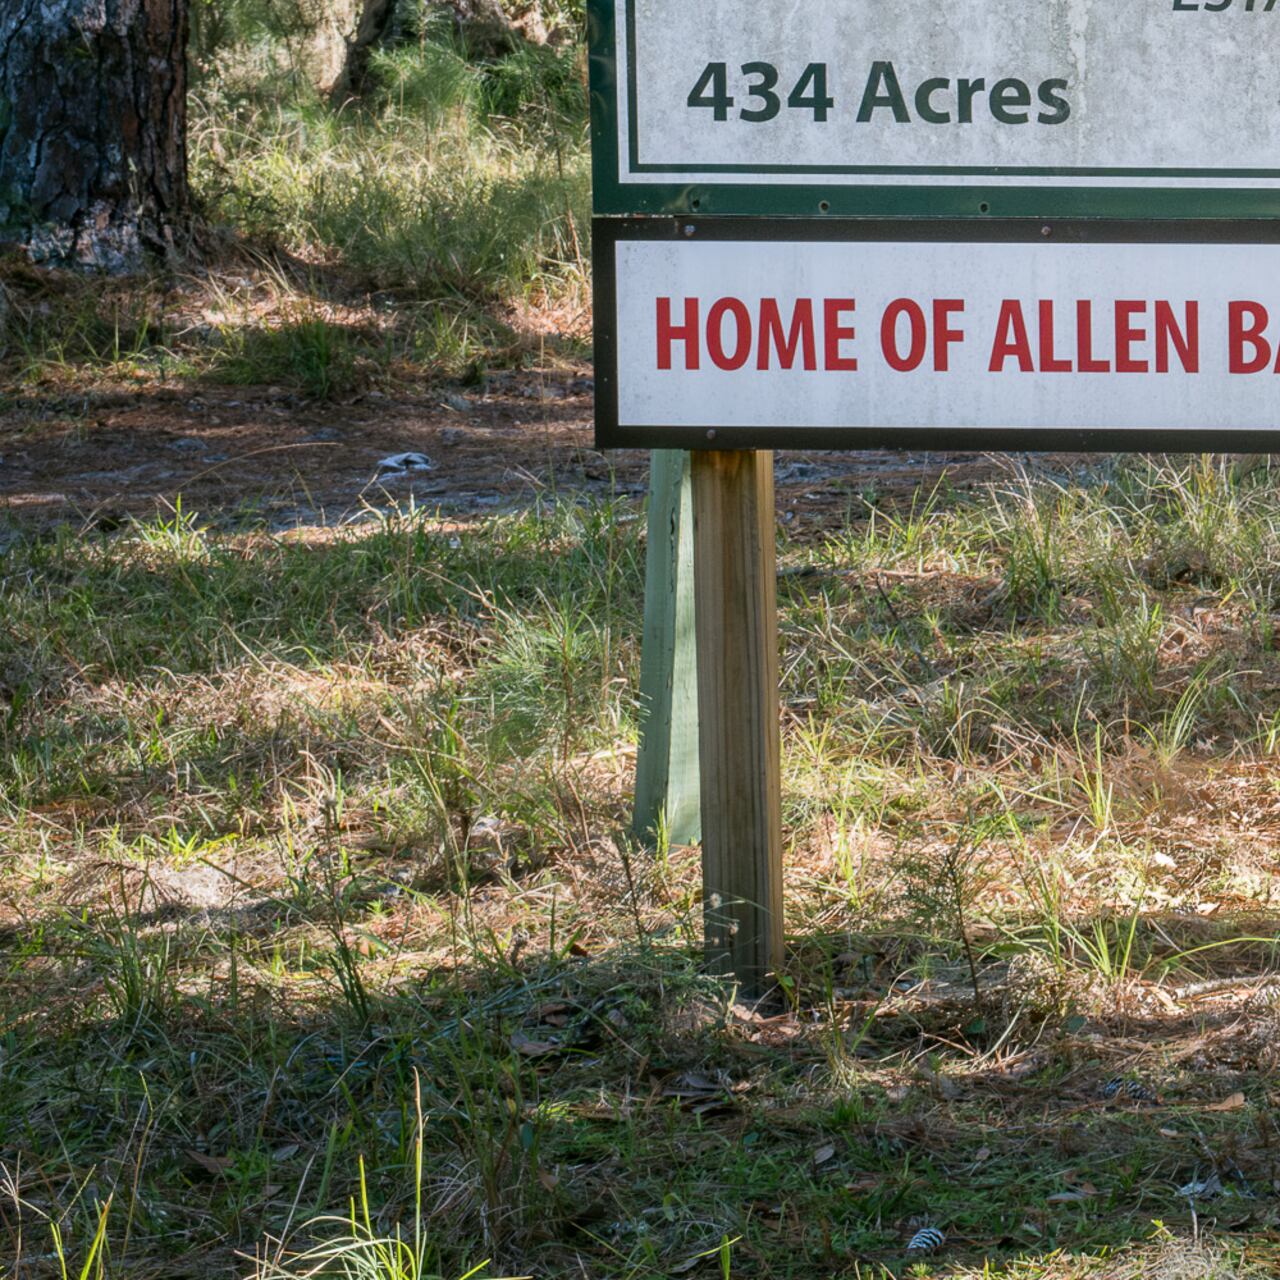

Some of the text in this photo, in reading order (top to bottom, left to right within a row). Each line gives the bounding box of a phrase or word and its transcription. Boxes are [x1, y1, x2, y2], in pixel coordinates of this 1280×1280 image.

[688, 62, 1070, 124] 434 Acres
[656, 298, 856, 370] HOME
[881, 299, 963, 371] OF
[989, 300, 1198, 372] ALLEN
